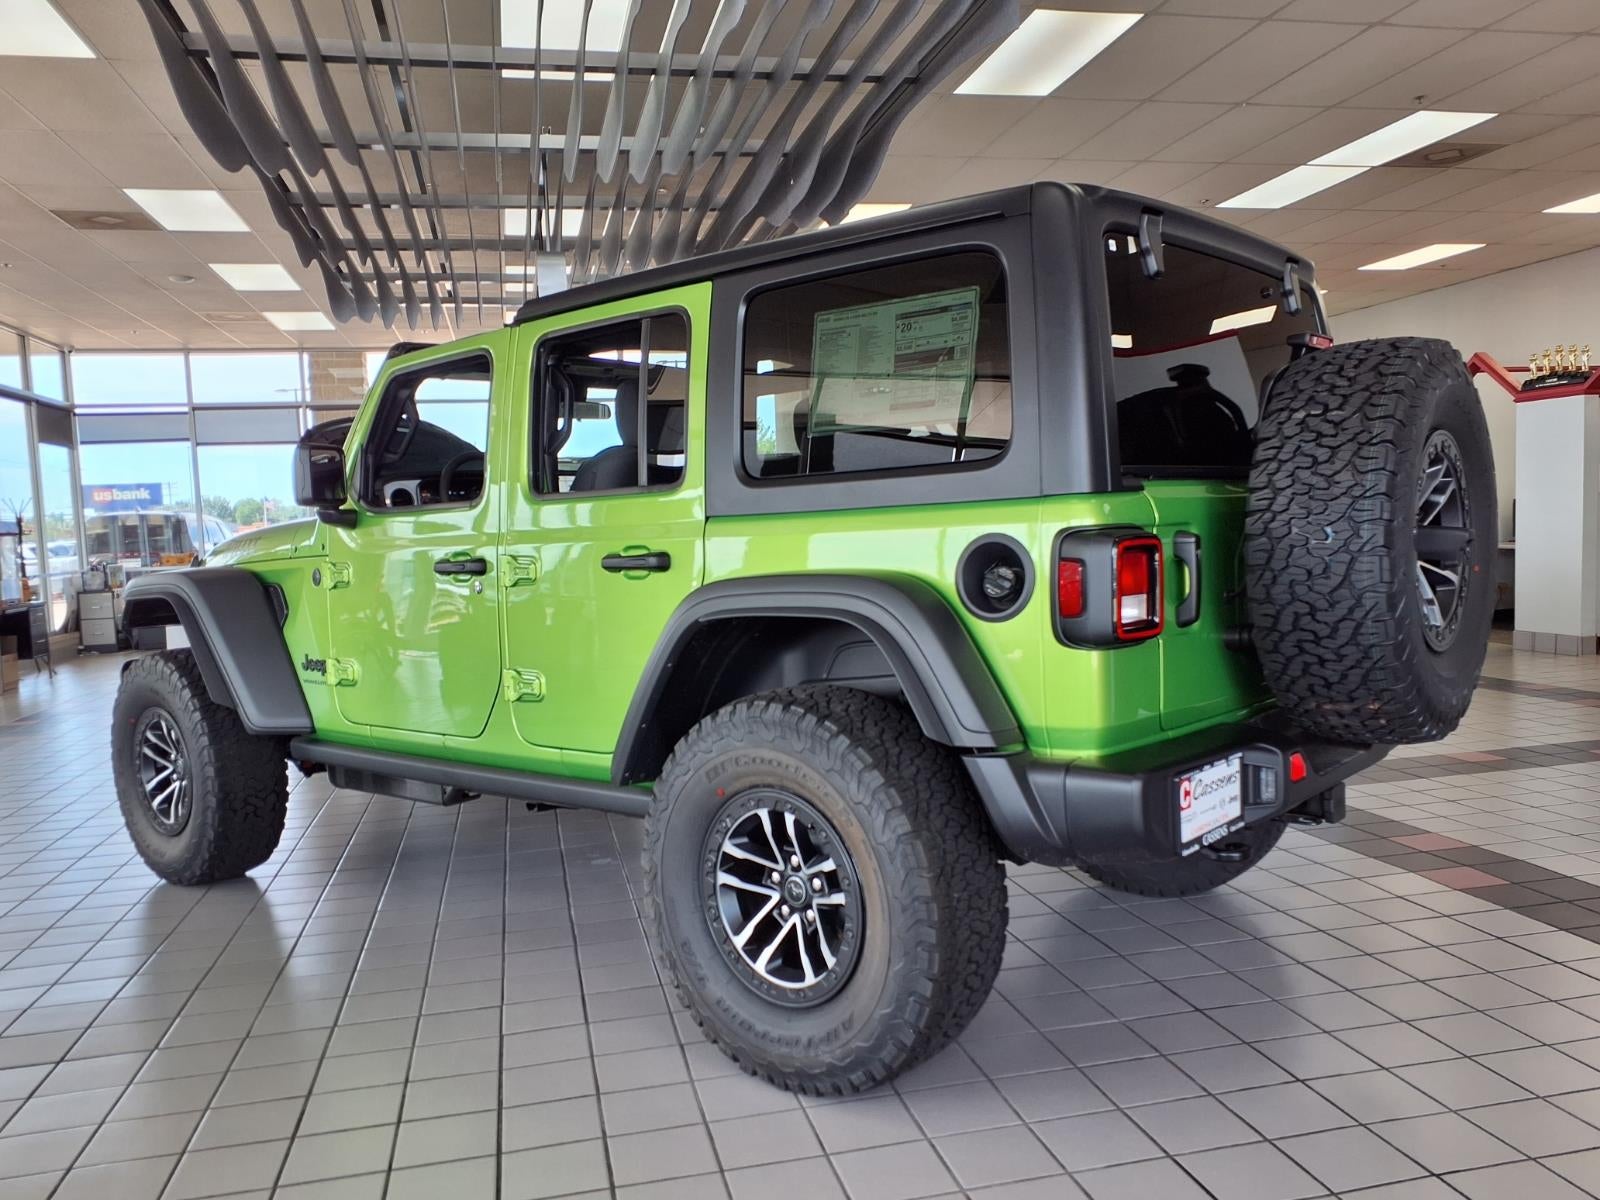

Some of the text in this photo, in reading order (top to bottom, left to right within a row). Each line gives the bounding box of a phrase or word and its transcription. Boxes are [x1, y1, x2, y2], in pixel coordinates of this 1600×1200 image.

[900, 321, 913, 333] 20
[301, 653, 327, 677] Jeep
[1192, 773, 1238, 801] Cassens
